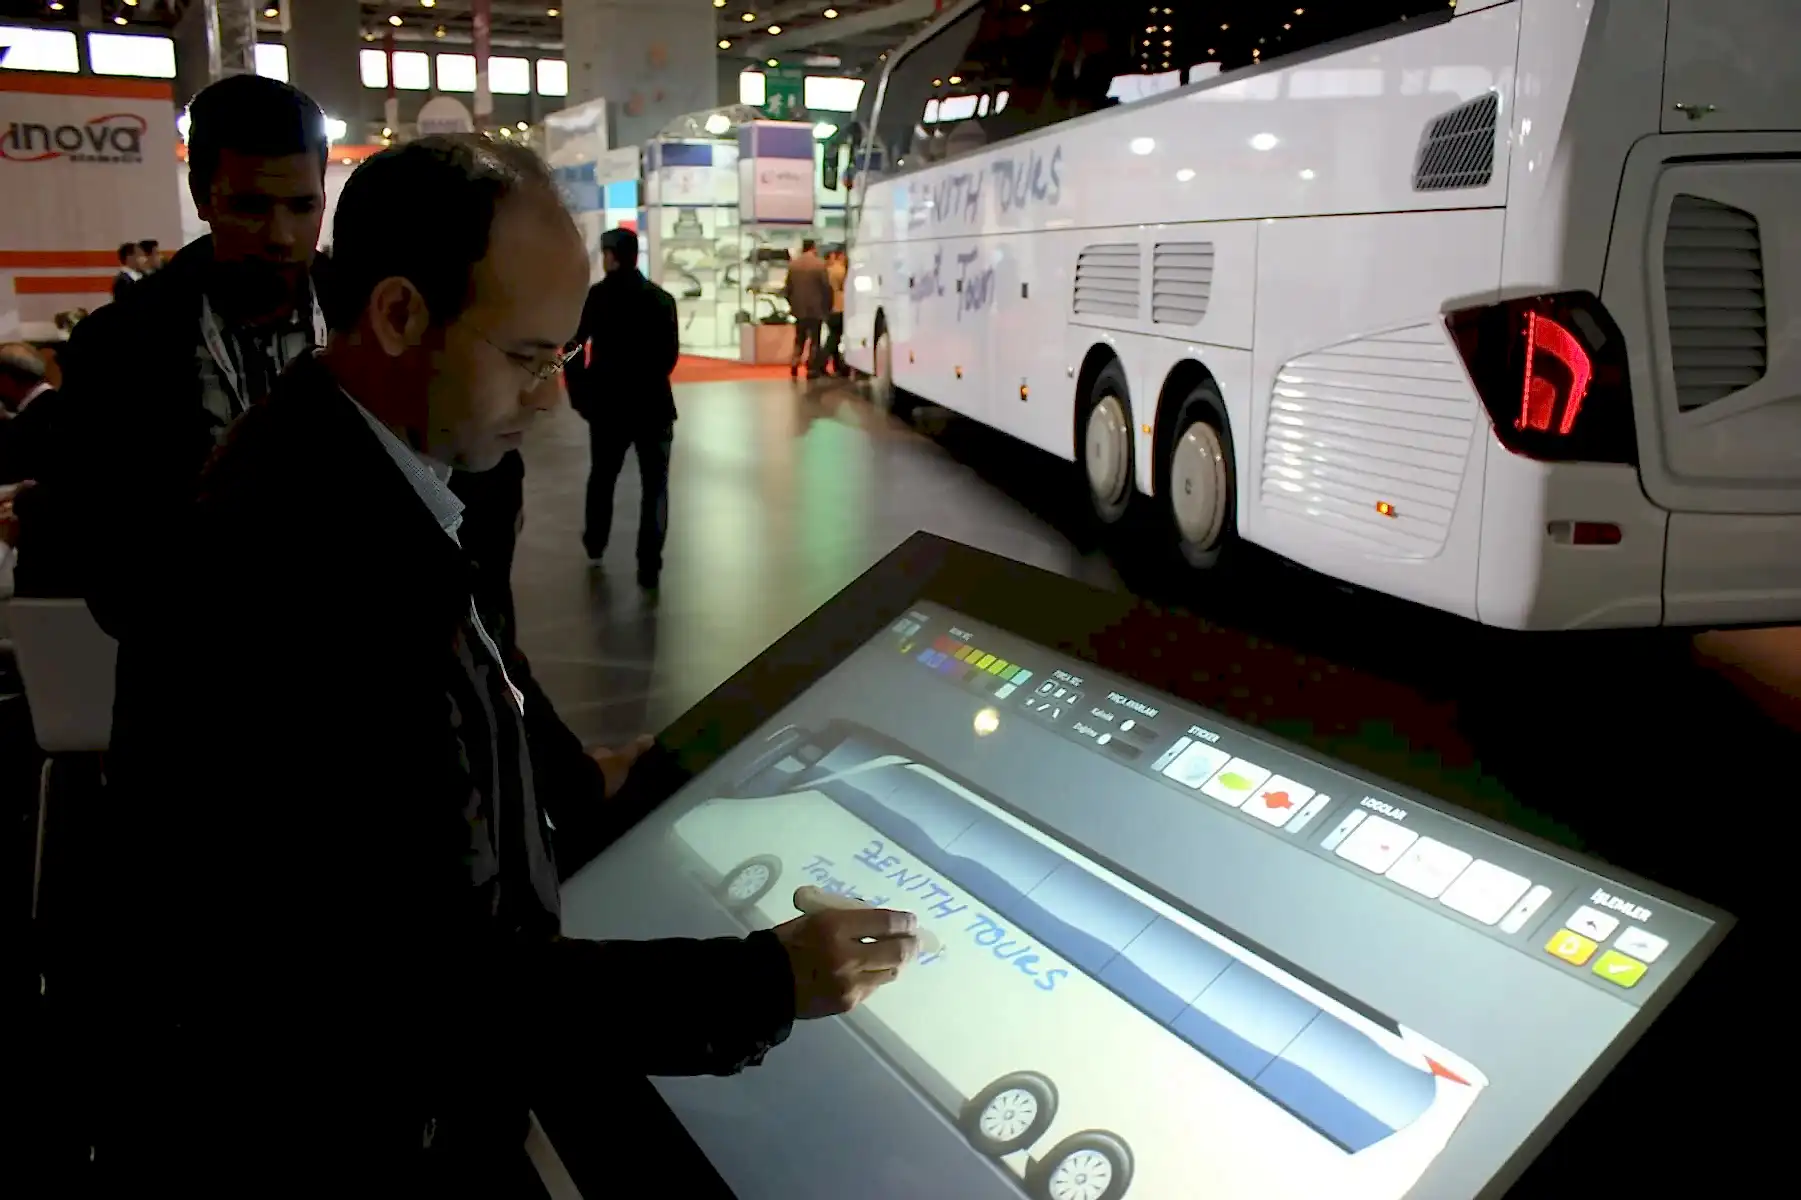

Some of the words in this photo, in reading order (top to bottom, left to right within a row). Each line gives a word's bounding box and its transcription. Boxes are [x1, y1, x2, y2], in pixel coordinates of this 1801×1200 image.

[8, 121, 141, 154] inova
[991, 144, 1063, 214] TOURS
[1359, 795, 1408, 821] LOGOLAR
[964, 912, 1069, 991] TOURS
